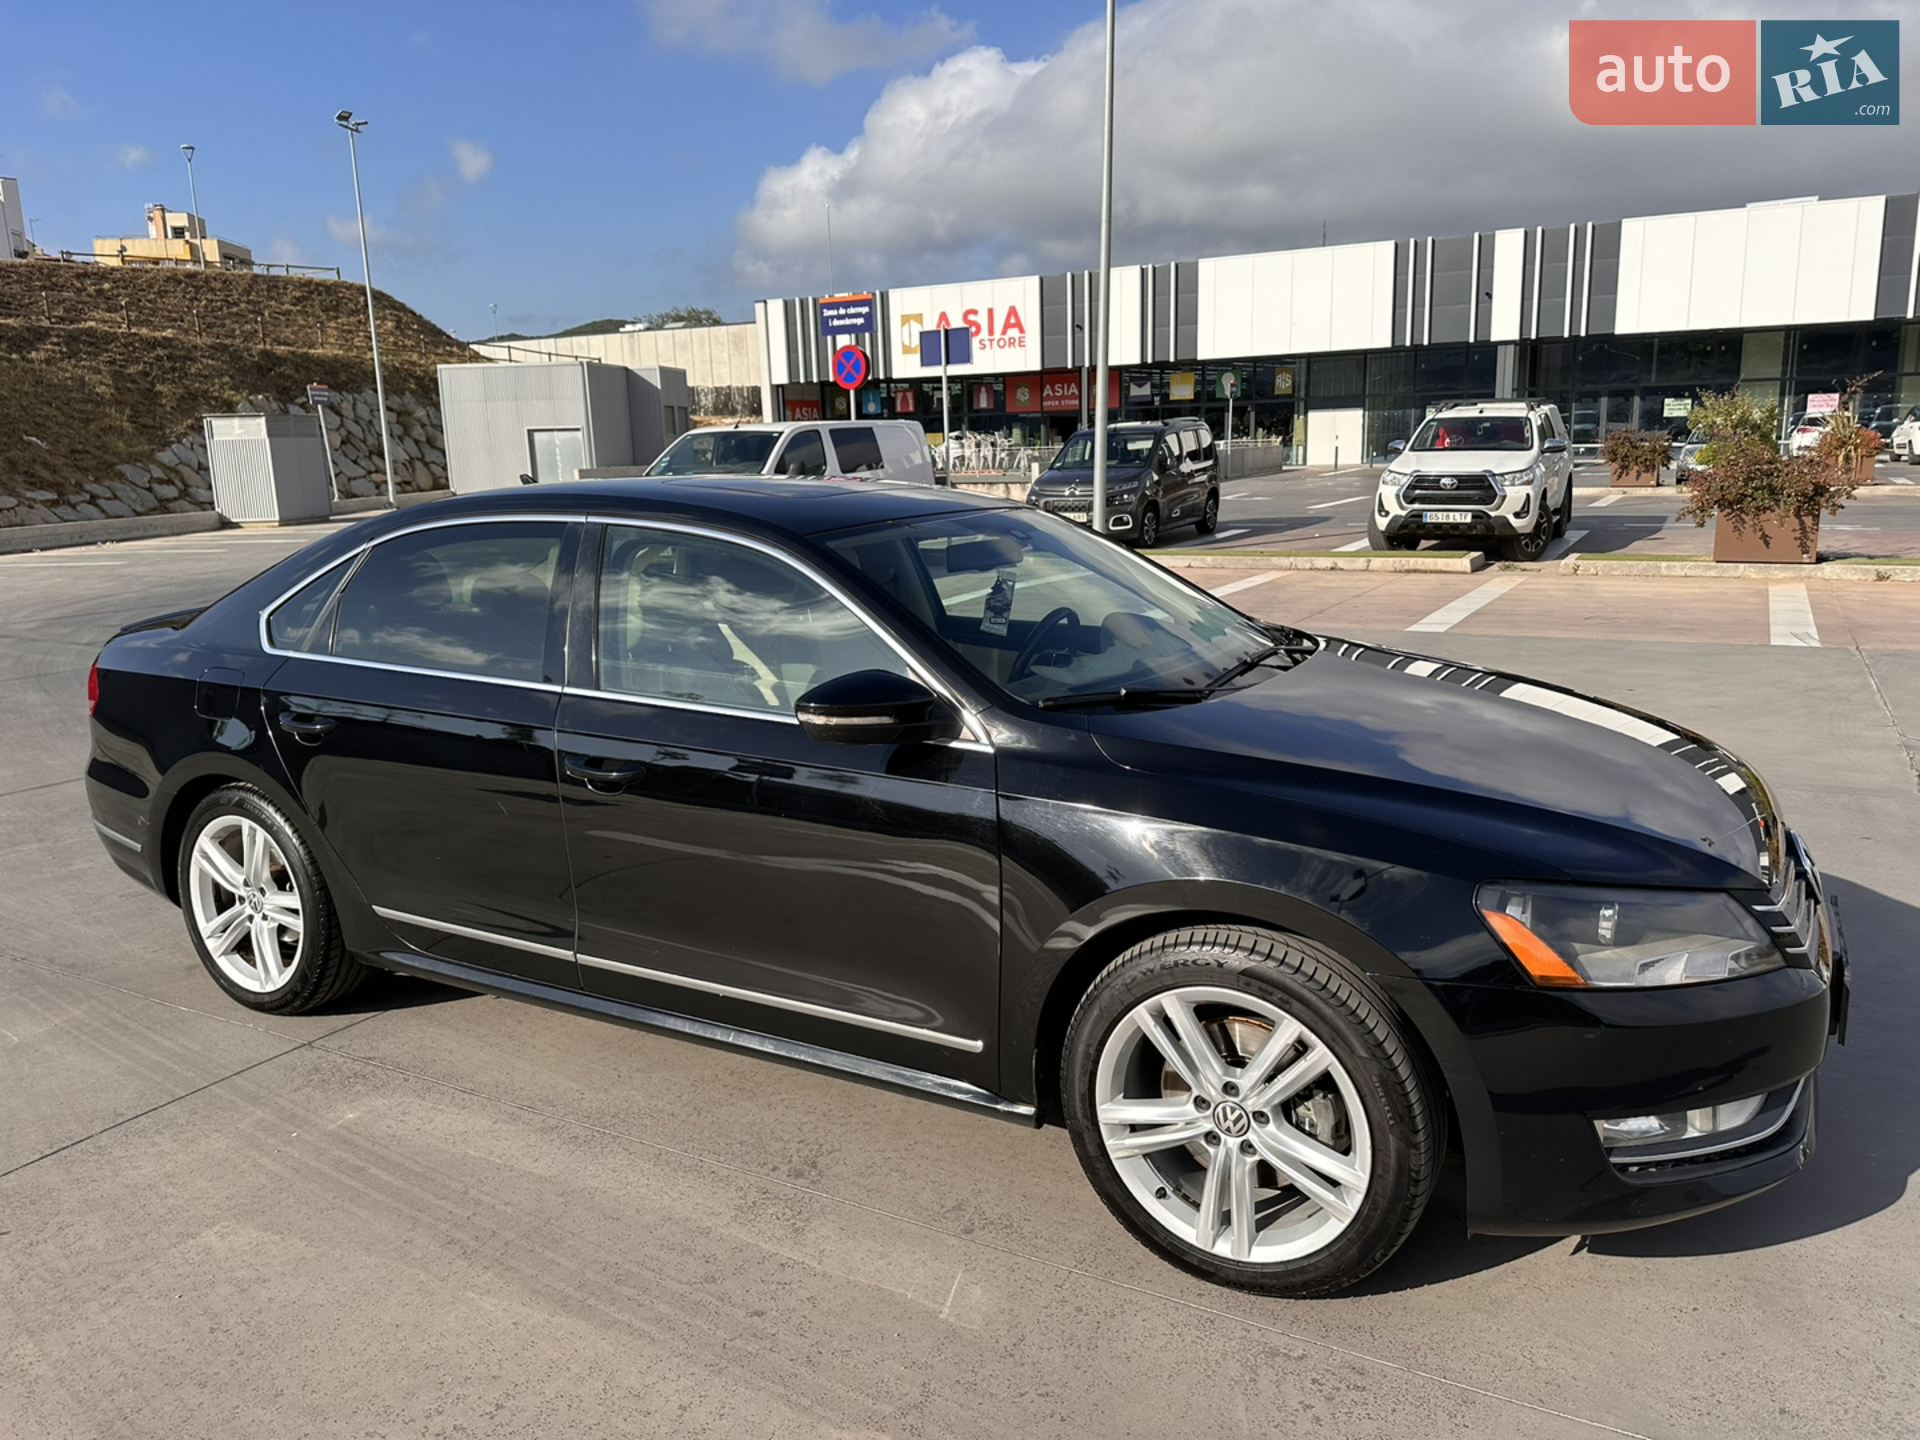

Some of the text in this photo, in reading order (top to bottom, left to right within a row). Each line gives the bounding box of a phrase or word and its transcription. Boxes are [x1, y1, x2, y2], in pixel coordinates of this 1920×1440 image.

[935, 305, 1026, 338] ASIA
[978, 335, 1026, 350] STORE
[1042, 382, 1079, 397] ASIA
[794, 406, 820, 421] ASIA
